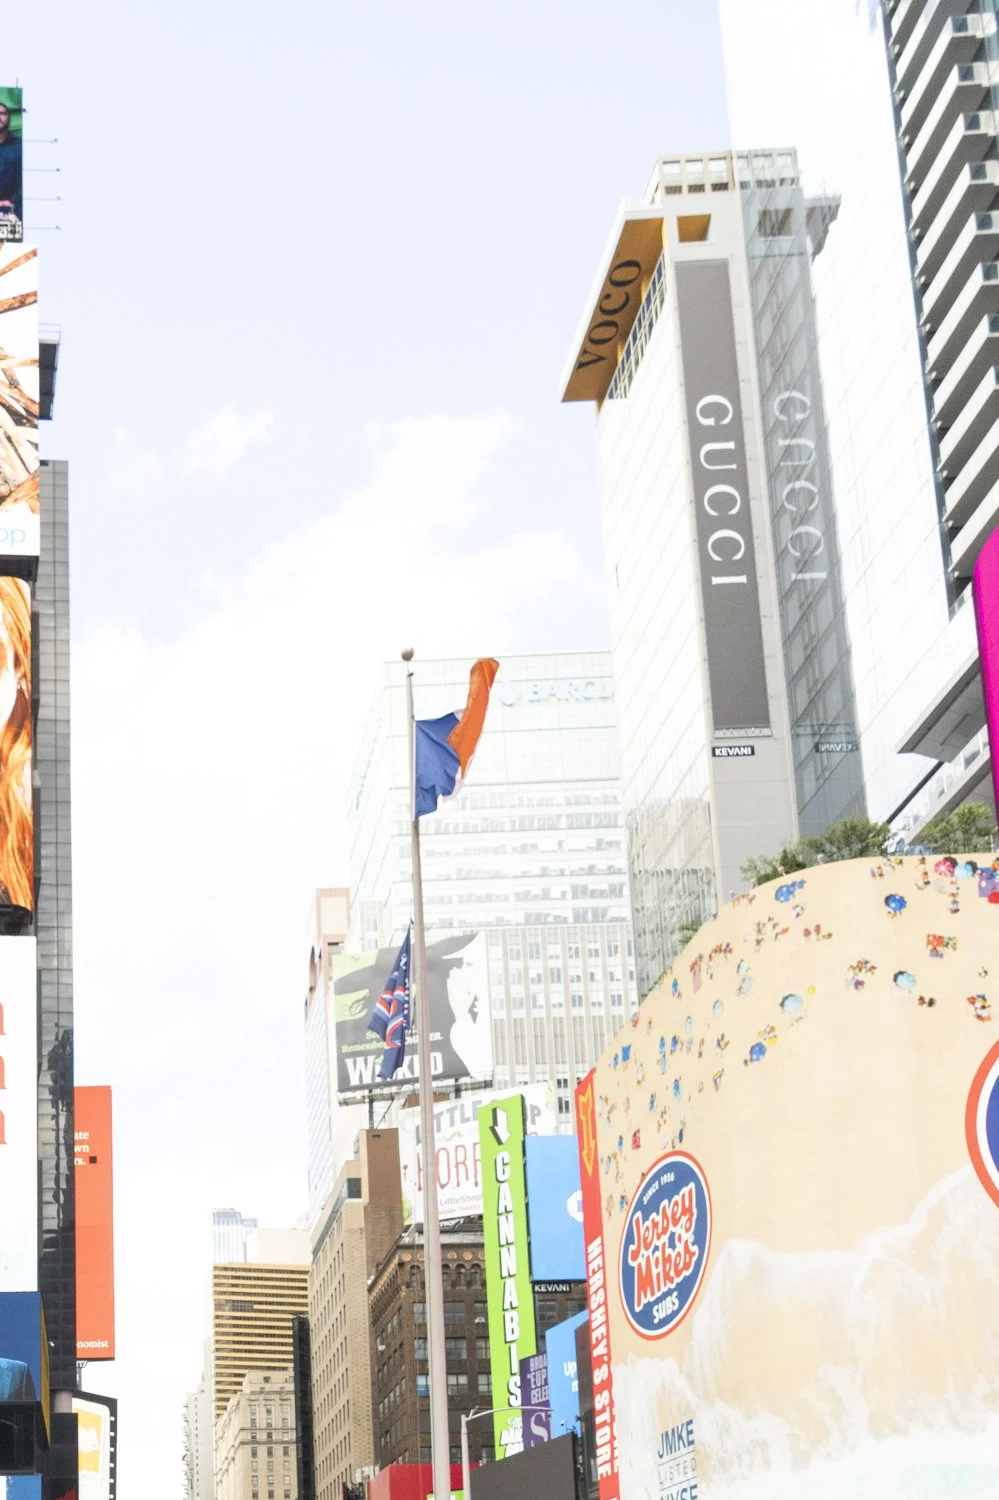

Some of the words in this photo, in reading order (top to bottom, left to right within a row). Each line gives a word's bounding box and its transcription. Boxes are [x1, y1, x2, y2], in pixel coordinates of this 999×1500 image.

[695, 393, 748, 586] GUCCI
[714, 746, 752, 756] KEVANI
[341, 1040, 386, 1054] Remembe
[643, 1180, 659, 1205] SINCE
[628, 1182, 697, 1265] Jersey
[494, 1151, 522, 1408] CANNABIS
[534, 1284, 570, 1292] KEVANI
[634, 1233, 698, 1312] Mike's
[587, 1235, 610, 1386] HERSHEY'S
[652, 1291, 680, 1324] SUBS
[595, 1389, 612, 1481] STORE
[657, 1418, 695, 1459] JMKE
